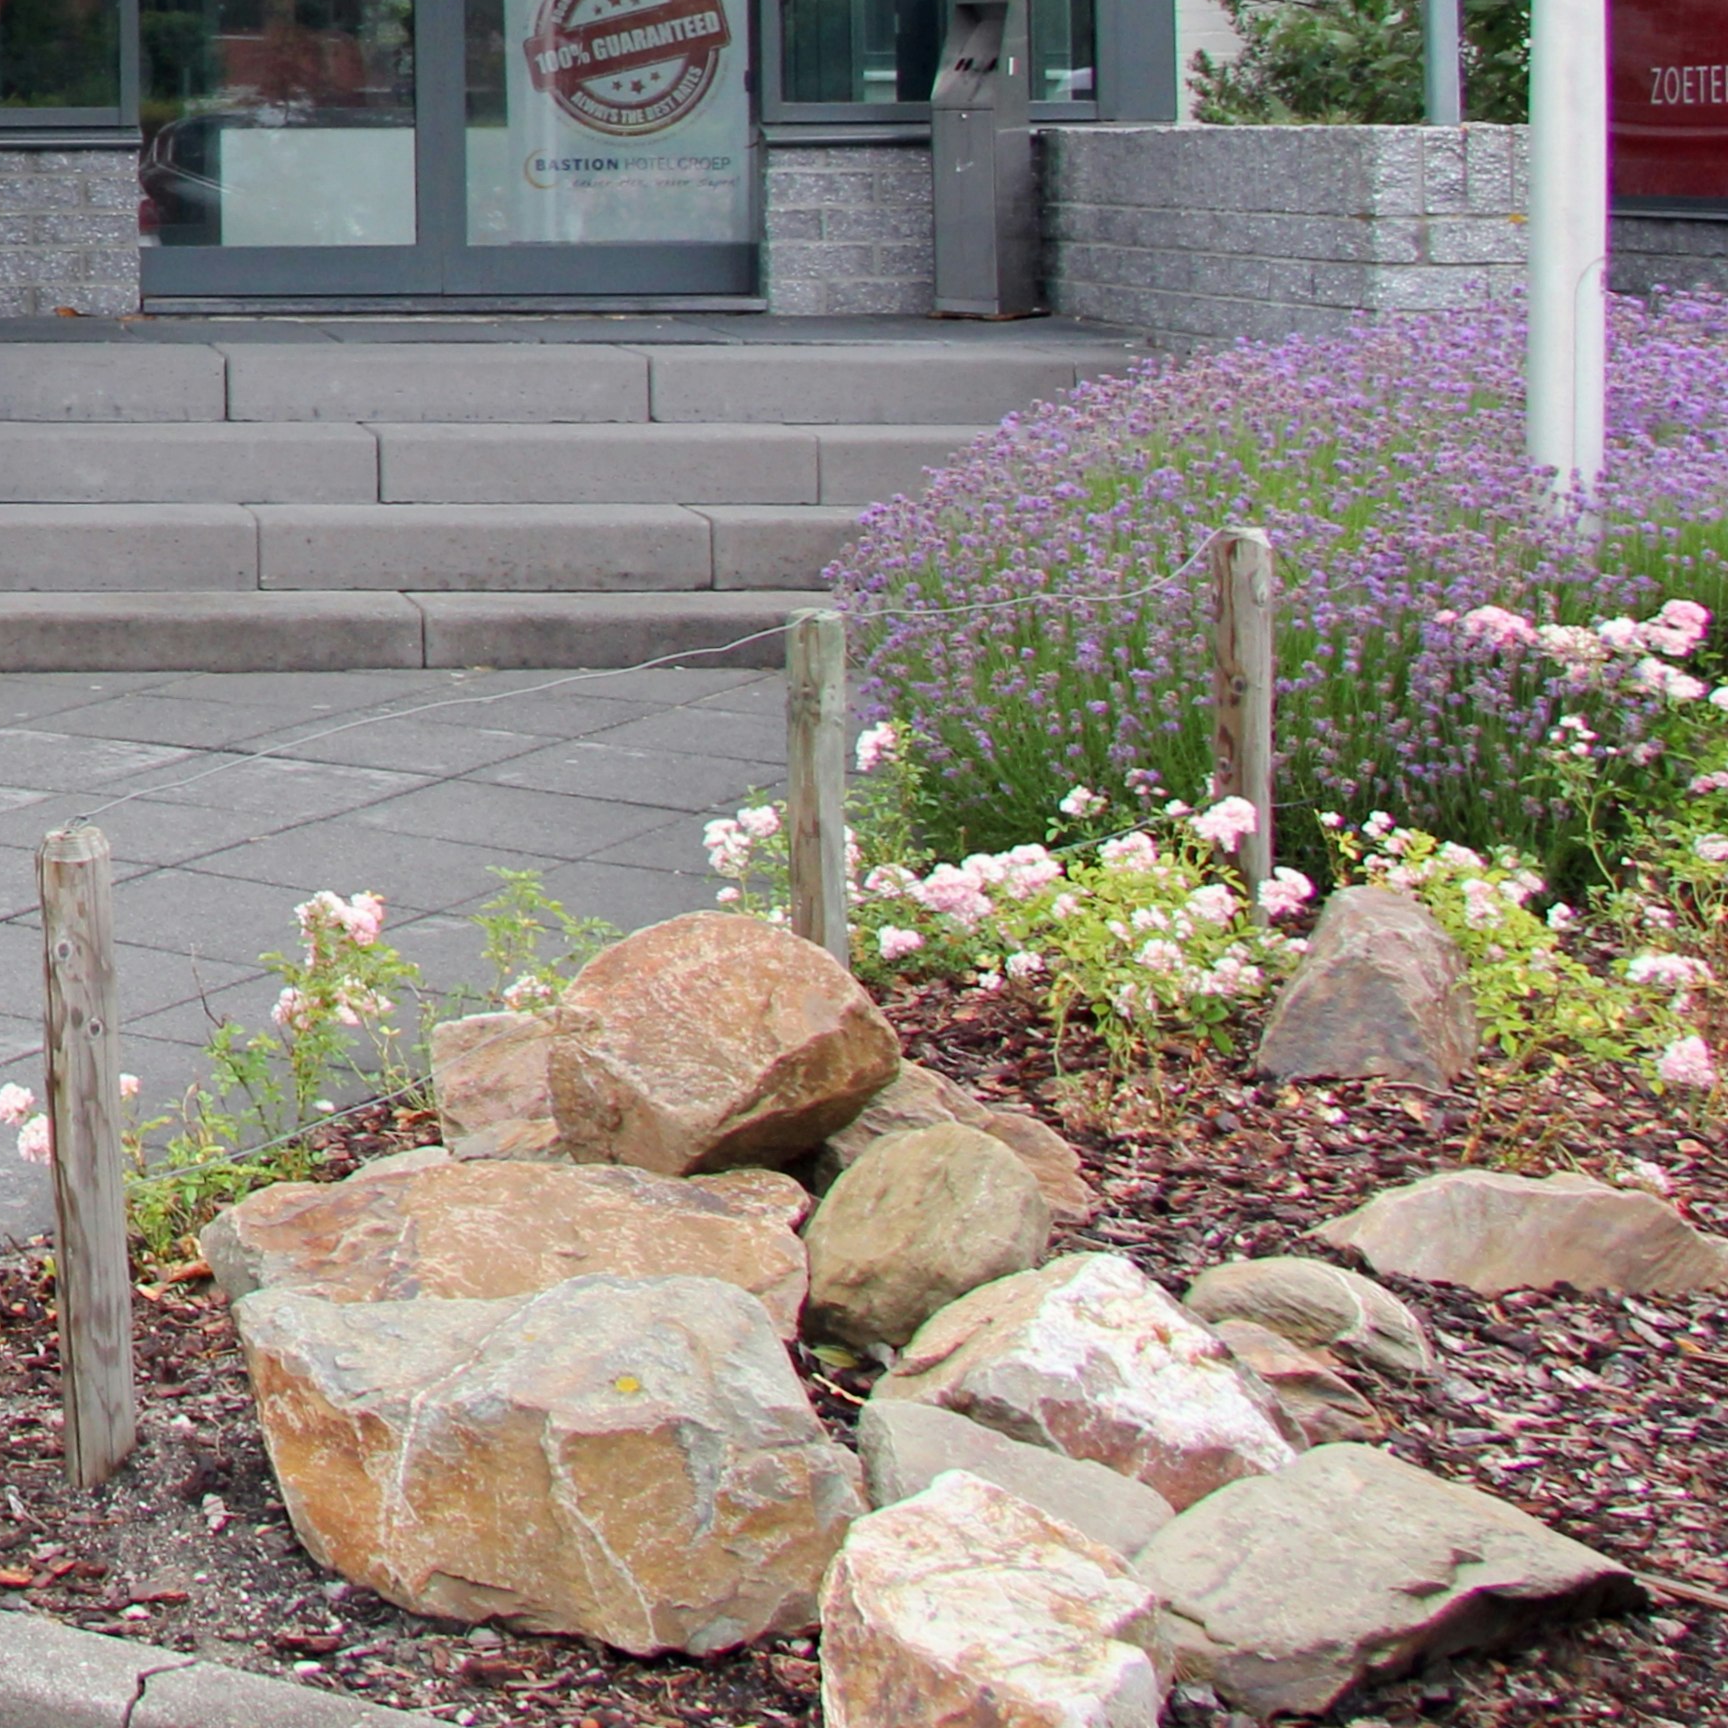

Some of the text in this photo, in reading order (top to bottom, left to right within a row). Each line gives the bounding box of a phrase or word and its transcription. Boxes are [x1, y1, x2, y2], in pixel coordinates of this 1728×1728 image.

[534, 10, 722, 74] 100% GUARANTEED
[1650, 65, 1728, 105] ZOETE
[621, 109, 645, 124] THE
[645, 97, 677, 122] BEST
[534, 157, 619, 172] BASTION
